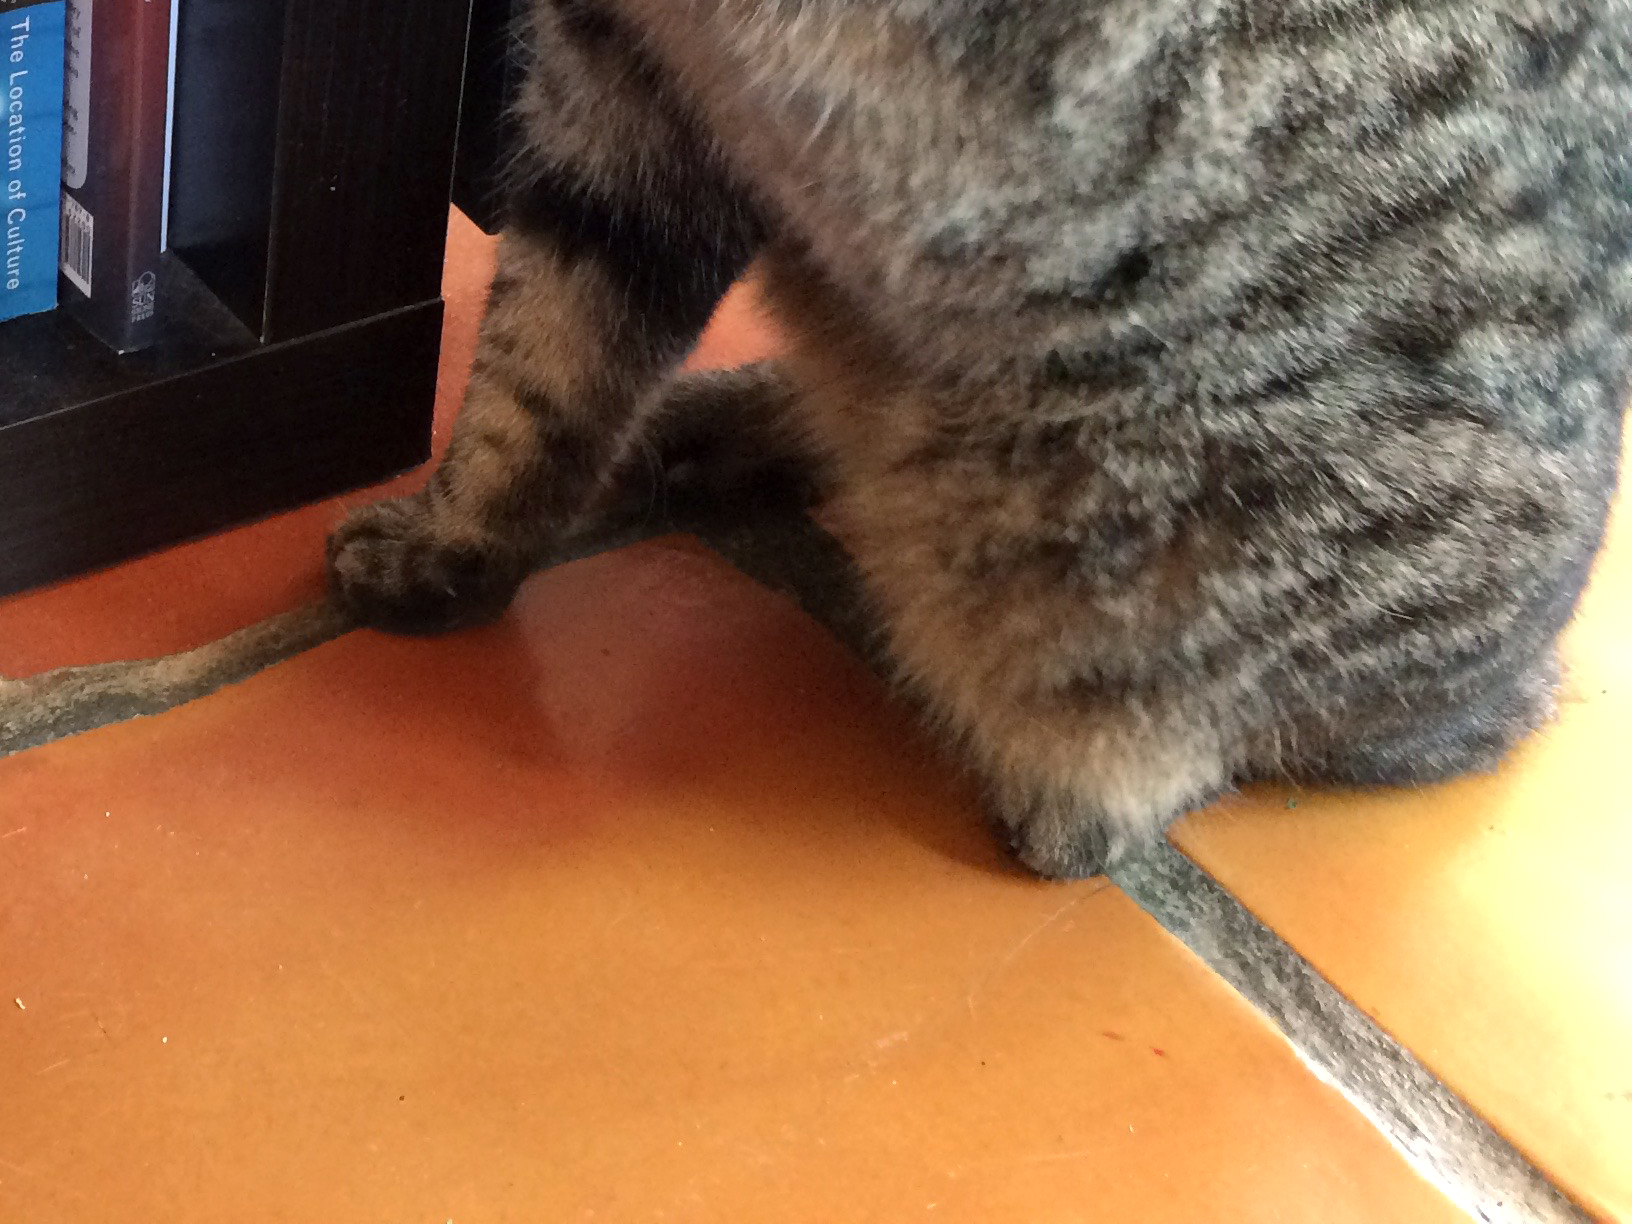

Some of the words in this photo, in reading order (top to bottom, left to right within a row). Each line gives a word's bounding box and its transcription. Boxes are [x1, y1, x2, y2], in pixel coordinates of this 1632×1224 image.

[8, 15, 30, 63] The
[8, 70, 29, 172] Location
[8, 179, 27, 203] of
[6, 208, 26, 290] Culture
